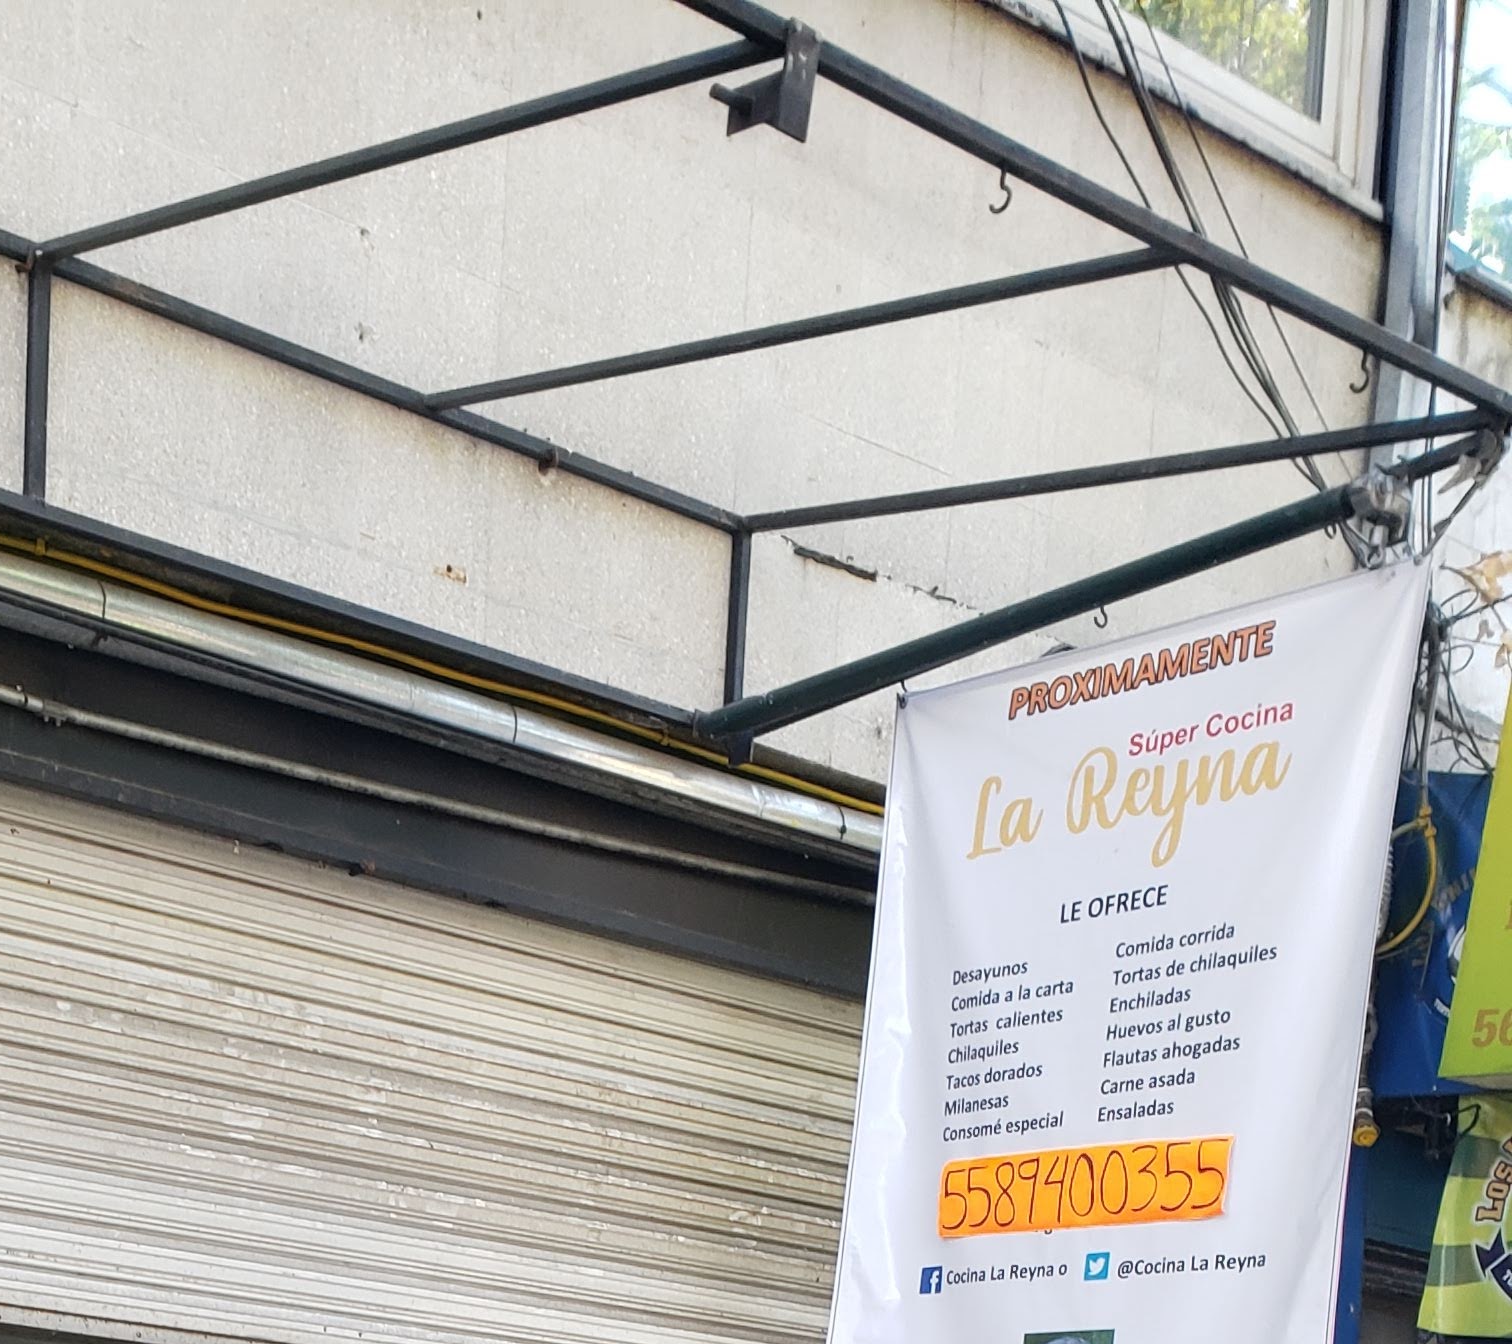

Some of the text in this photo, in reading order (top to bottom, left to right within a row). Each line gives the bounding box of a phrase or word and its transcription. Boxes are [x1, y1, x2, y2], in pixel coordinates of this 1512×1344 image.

[1008, 620, 1276, 720] PROXIMAMENTE
[1129, 702, 1294, 756] Súper Cocina
[966, 740, 1292, 867] La Reyna
[1060, 885, 1169, 923] LE OFRECE
[1115, 922, 1235, 958] Comida corrida
[952, 961, 1029, 985] Desayunos
[1113, 945, 1277, 985] Tortas de chilaquiles
[951, 980, 1074, 1012] Comida a la carta
[1109, 987, 1192, 1013] Enchiladas
[950, 1008, 1063, 1038] Tortas calientes
[1106, 1009, 1231, 1041] Huevos al gusto
[948, 1039, 1019, 1064] Chilaquiles
[1103, 1034, 1241, 1068] Flautas ahogadas
[946, 1062, 1043, 1090] Tacos dorados
[1100, 1068, 1196, 1095] Carne asada
[944, 1094, 1009, 1116] Milanesas
[1097, 1098, 1175, 1122] Ensaladas
[943, 1110, 1064, 1142] Consomé especial
[942, 1138, 1230, 1231] 5589400355
[946, 1263, 1068, 1286] Cocina La Reyna o
[1117, 1251, 1266, 1279] @Cocina La Reyna
